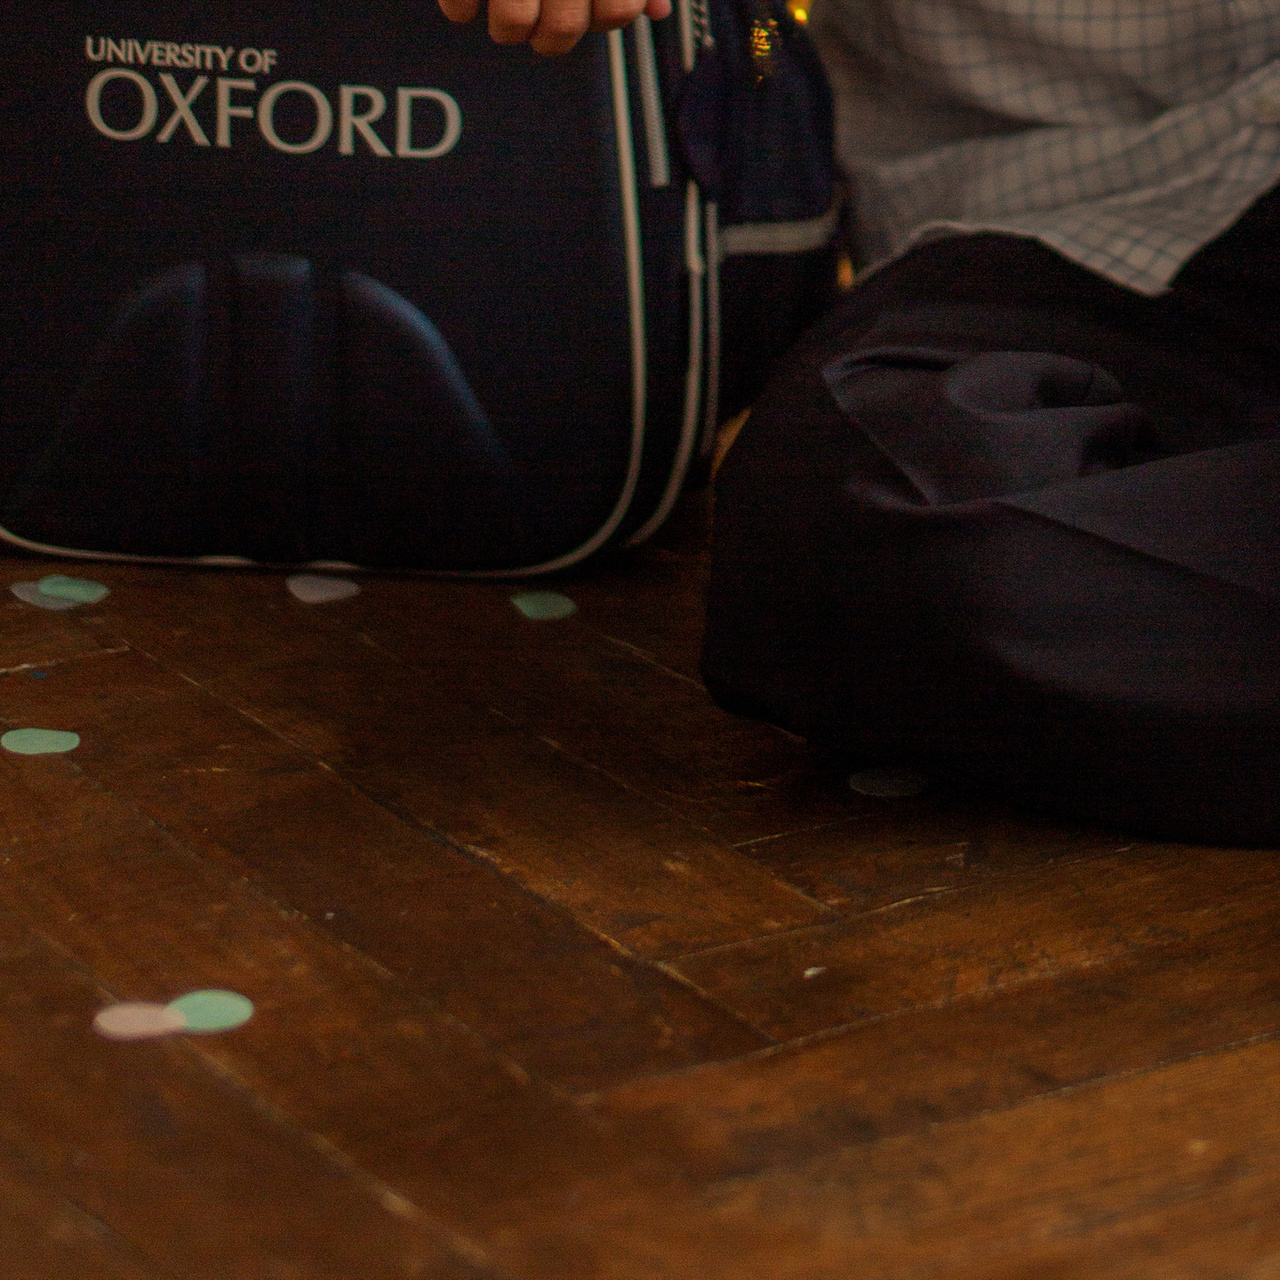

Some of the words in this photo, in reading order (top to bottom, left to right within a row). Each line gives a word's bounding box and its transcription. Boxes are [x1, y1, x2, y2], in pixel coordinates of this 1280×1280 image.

[86, 37, 234, 71] UNIVERSITY
[239, 47, 277, 74] OF
[85, 67, 463, 159] OXFORD
